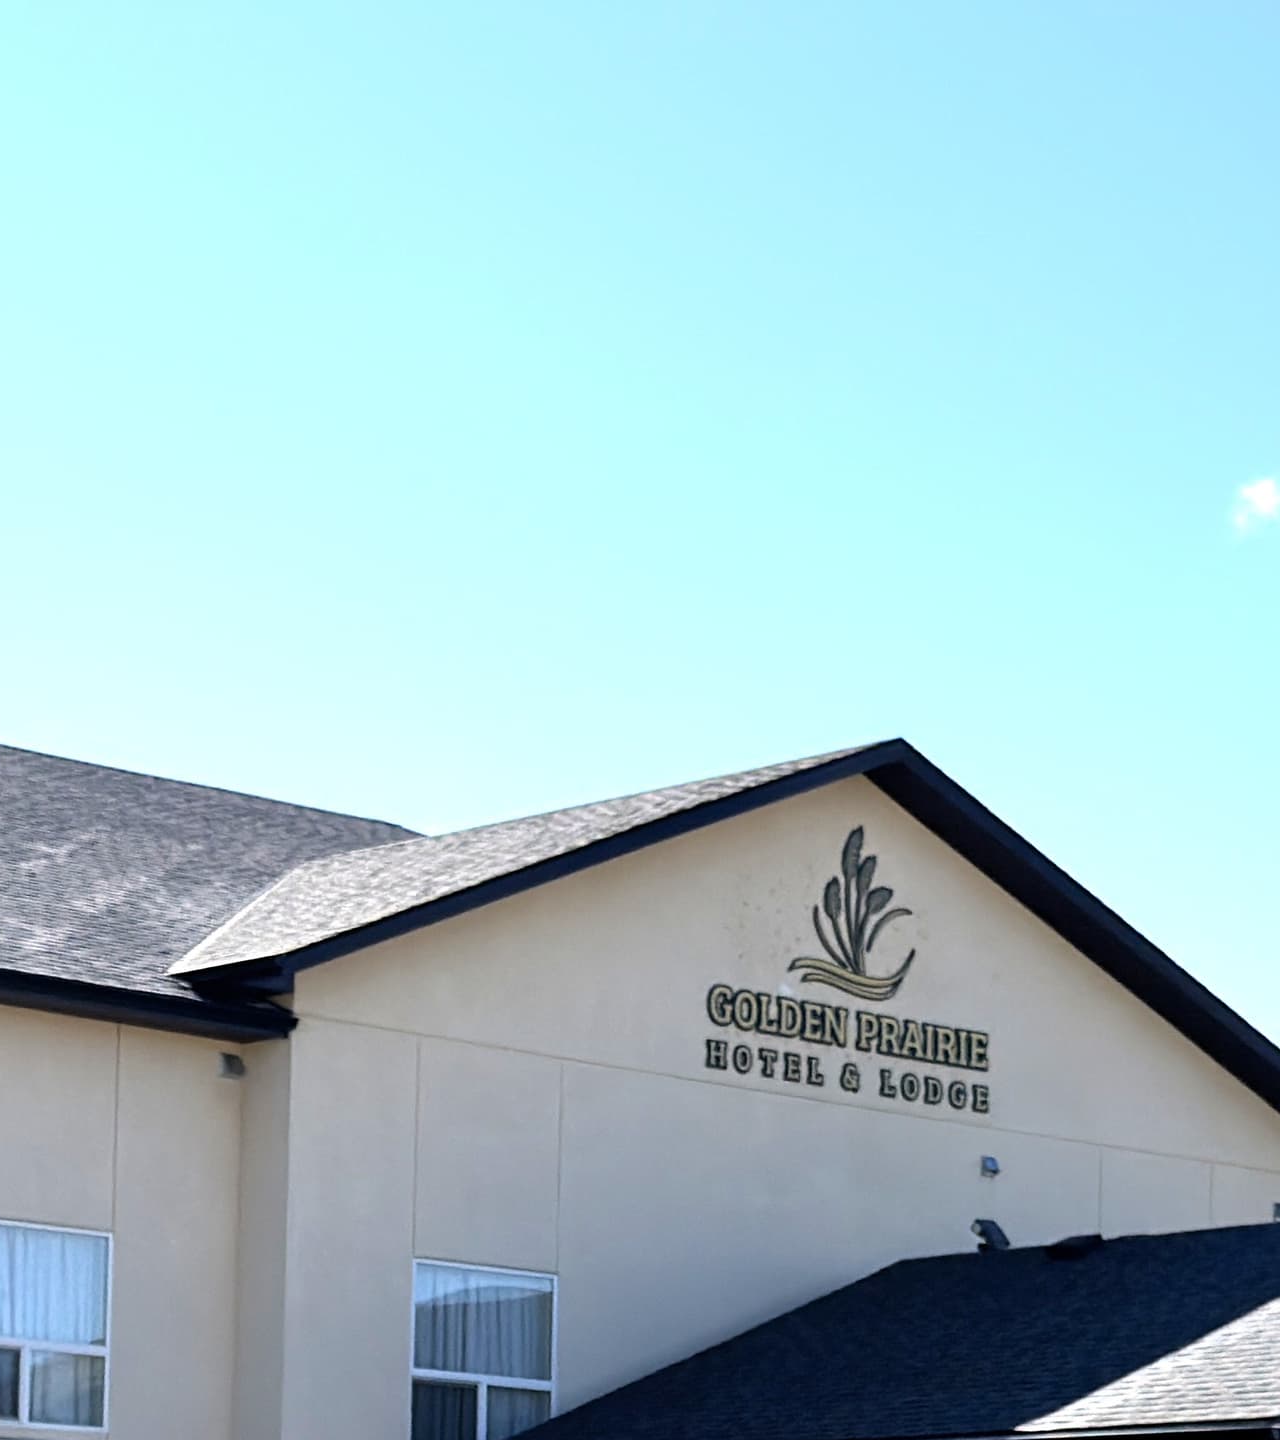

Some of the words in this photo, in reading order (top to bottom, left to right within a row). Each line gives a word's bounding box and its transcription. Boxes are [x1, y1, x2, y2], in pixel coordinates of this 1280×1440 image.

[706, 984, 848, 1048] GOLDEN
[856, 1010, 989, 1072] PRAIRIE
[705, 1039, 824, 1086] HOTEL
[840, 1062, 861, 1093] &
[879, 1068, 990, 1114] LODGE
